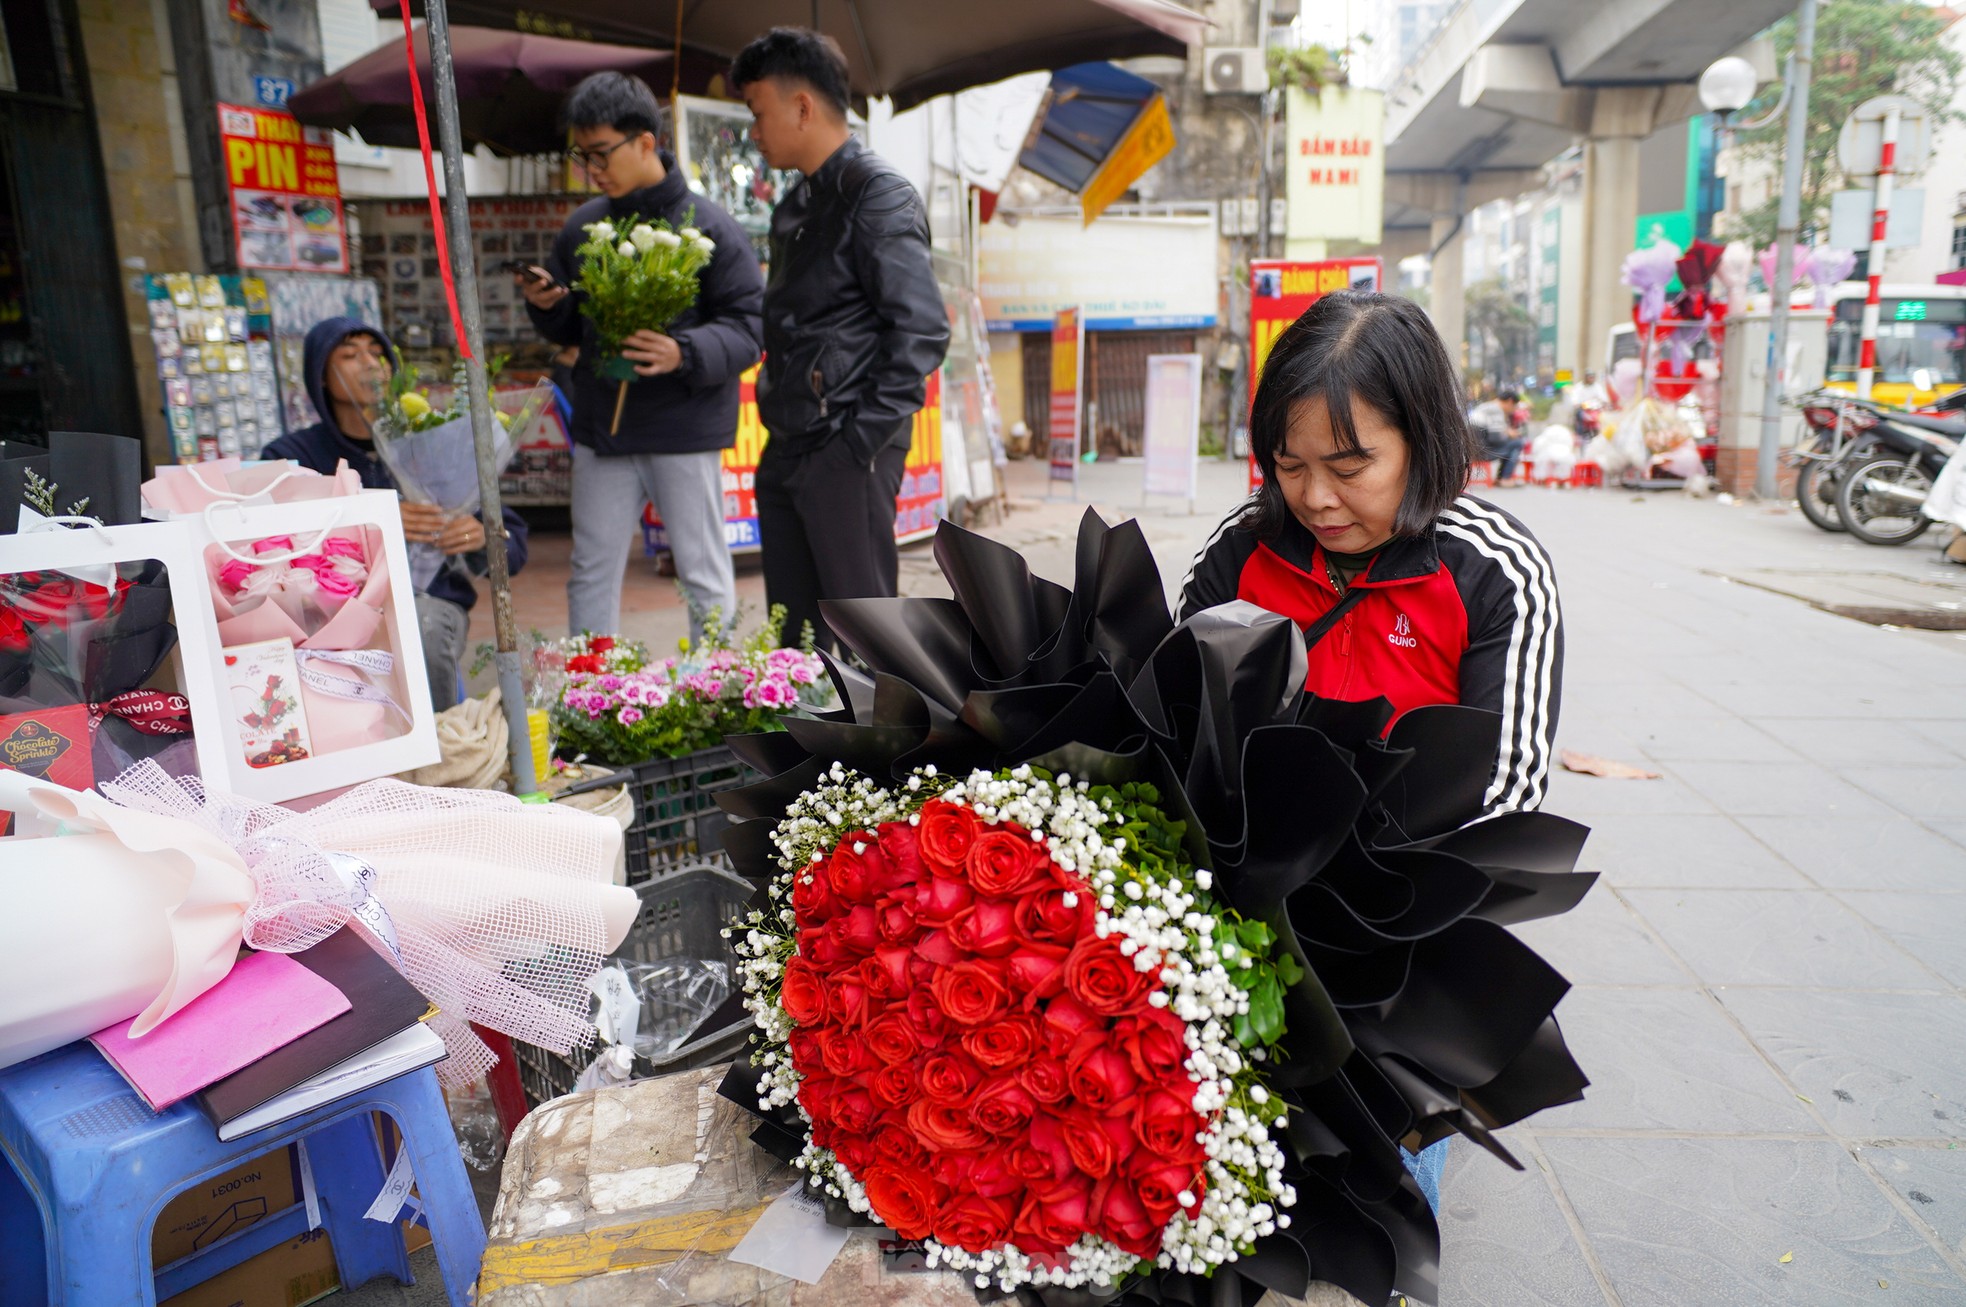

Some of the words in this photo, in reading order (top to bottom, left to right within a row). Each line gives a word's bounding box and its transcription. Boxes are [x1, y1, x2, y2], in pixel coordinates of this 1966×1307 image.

[228, 138, 299, 190] PIN
[1388, 633, 1417, 648] GUNO
[353, 652, 391, 669] CHANEL
[5, 736, 60, 754] Chocolate
[10, 746, 57, 764] Sprinkle
[211, 1170, 262, 1199] No.0031
